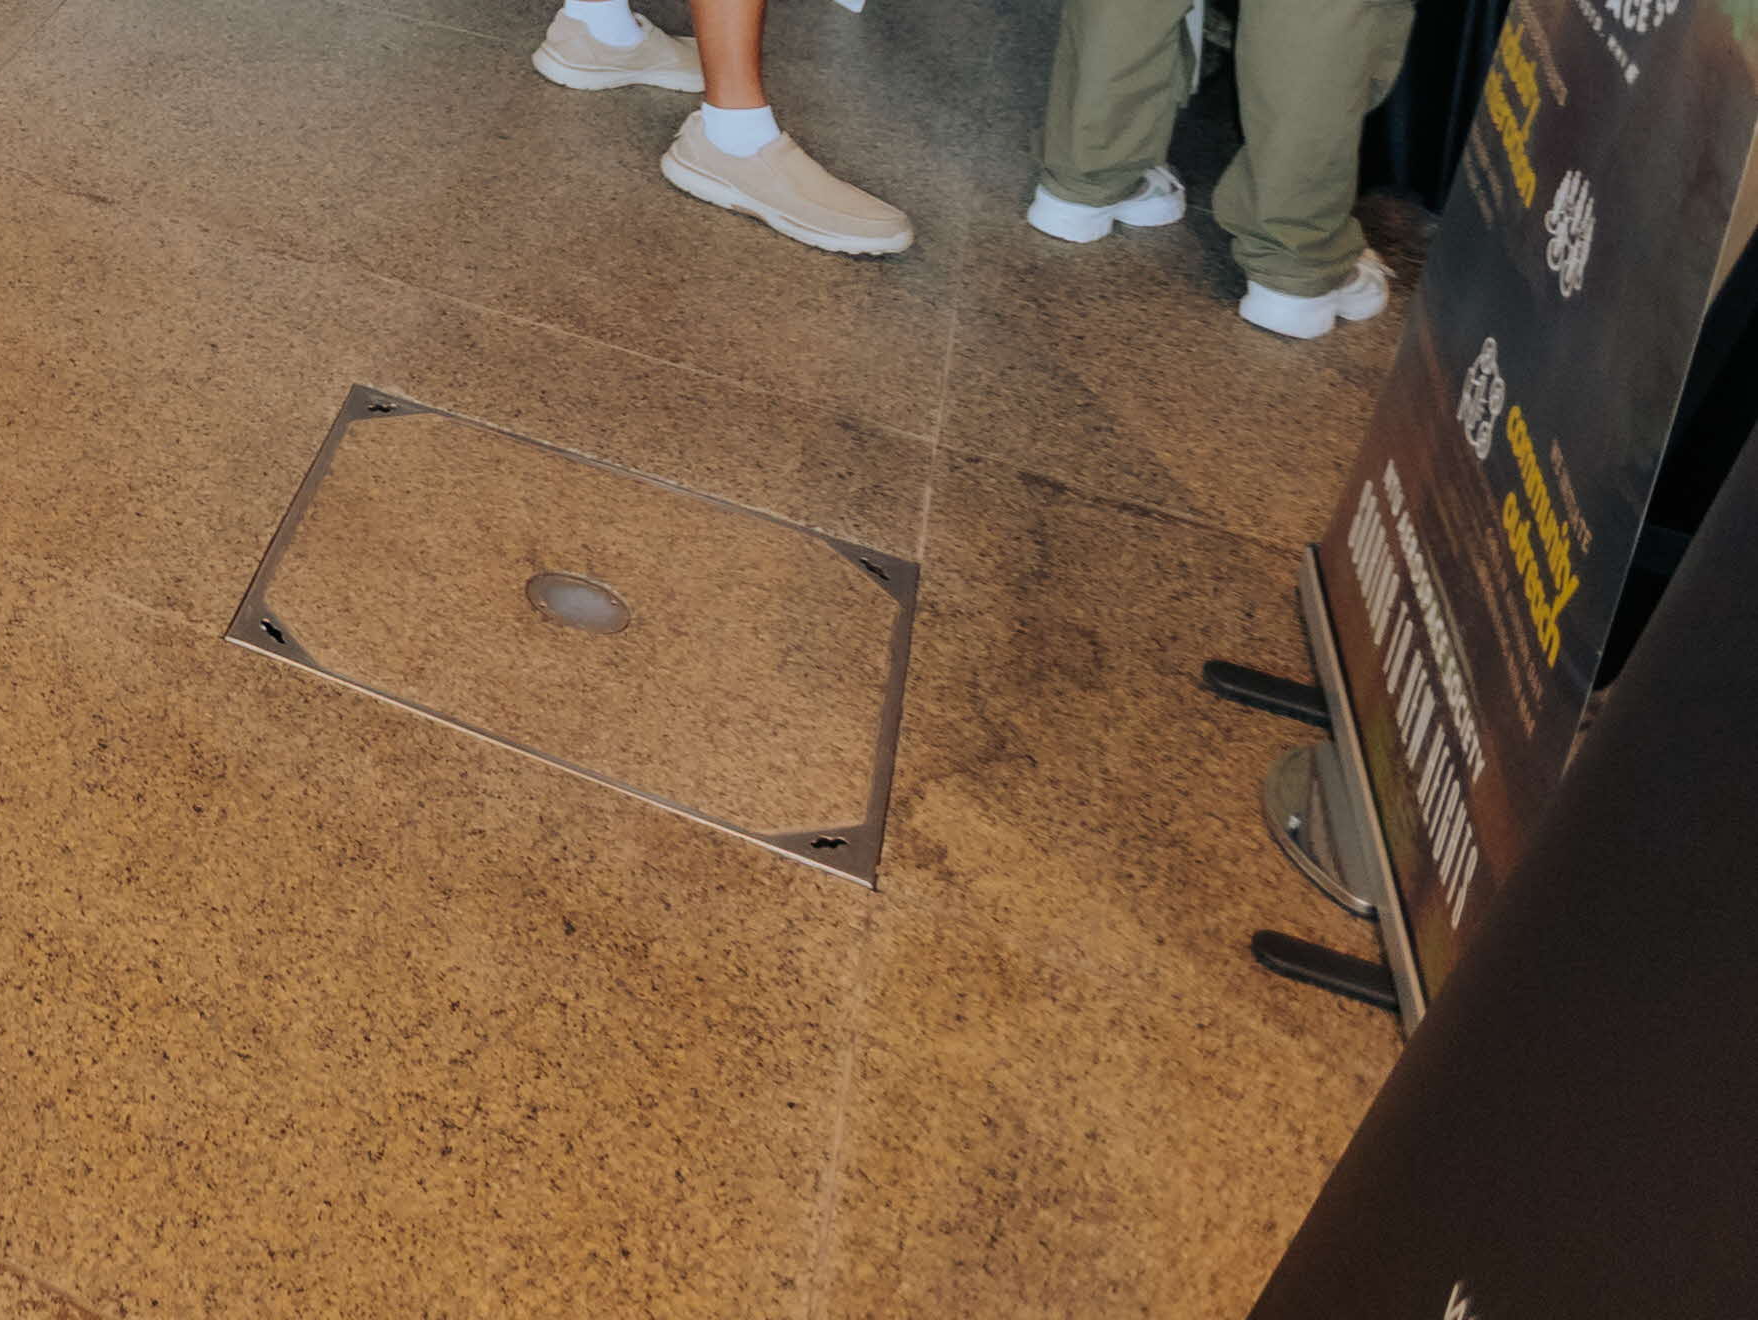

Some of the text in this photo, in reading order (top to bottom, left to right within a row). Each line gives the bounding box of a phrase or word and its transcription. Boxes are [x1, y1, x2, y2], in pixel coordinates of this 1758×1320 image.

[1502, 491, 1561, 670] outreach
[1506, 405, 1580, 618] community
[1443, 653, 1485, 785] SOCIETY
[1416, 722, 1479, 932] HEIGHTS
